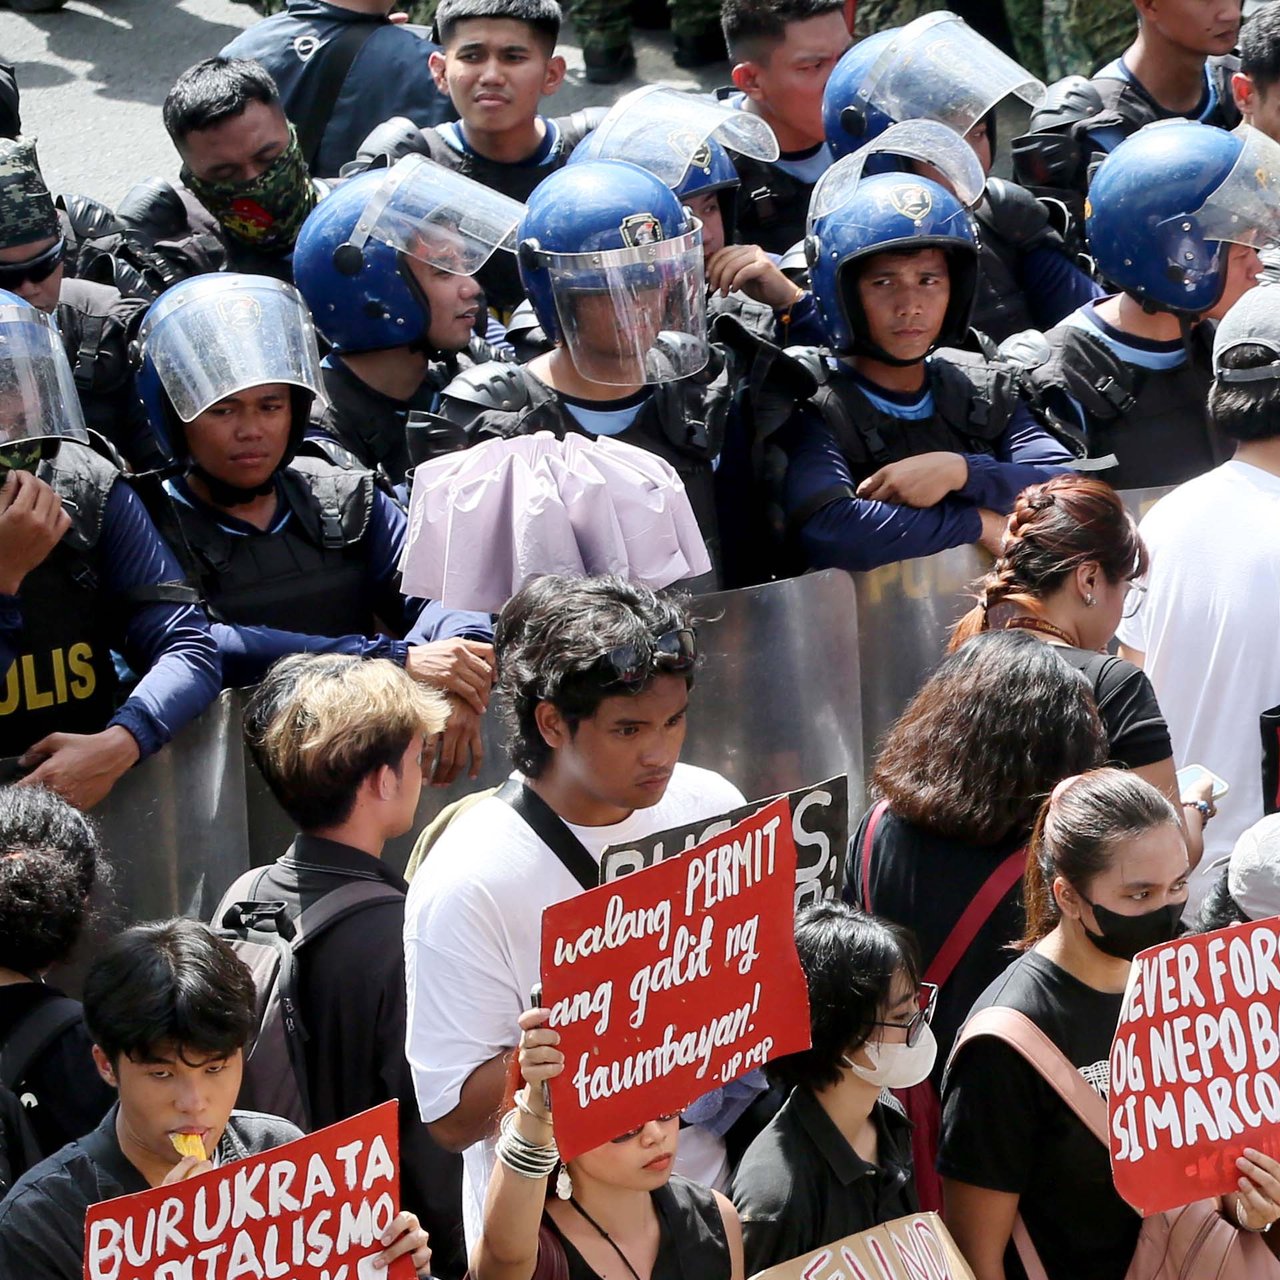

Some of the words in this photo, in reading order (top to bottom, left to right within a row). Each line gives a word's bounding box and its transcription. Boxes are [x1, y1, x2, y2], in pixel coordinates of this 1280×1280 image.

[0, 642, 96, 715] ULIS
[553, 894, 671, 967] walang
[684, 815, 781, 916] PERMIT
[549, 980, 612, 1036] ang
[629, 915, 713, 1029] galit
[725, 914, 760, 975] ng
[572, 982, 762, 1109] taumbayan!
[744, 1036, 774, 1067] rep
[1149, 1006, 1248, 1088] NEPO
[1111, 1095, 1145, 1163] SI
